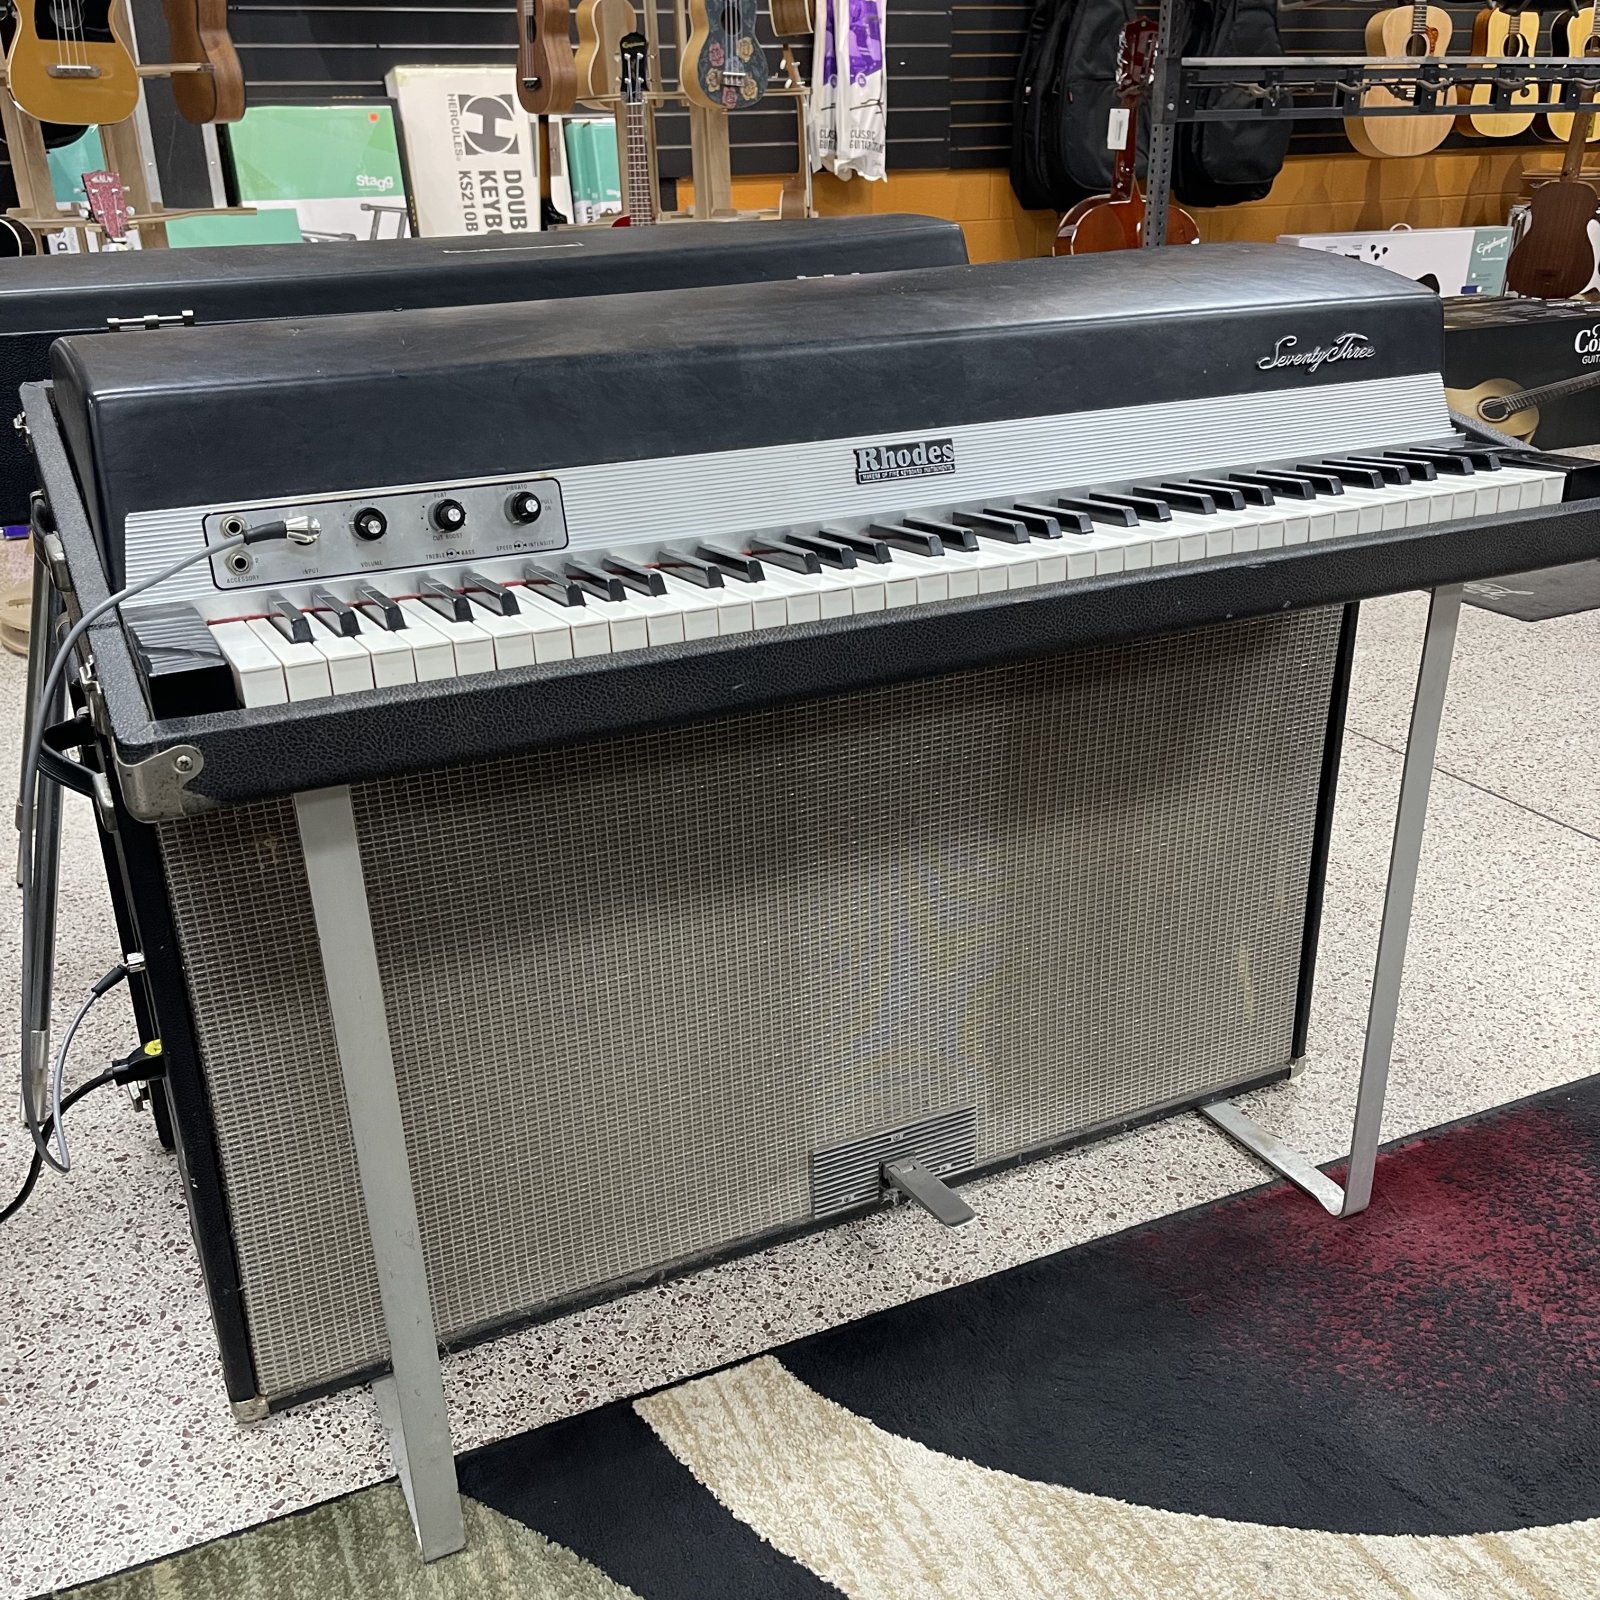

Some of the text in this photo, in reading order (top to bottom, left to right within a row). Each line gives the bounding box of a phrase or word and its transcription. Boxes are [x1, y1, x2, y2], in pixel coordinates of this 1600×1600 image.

[447, 93, 463, 156] HERCULES
[356, 174, 394, 191] Stagg
[458, 170, 479, 232] KS210B
[503, 170, 528, 230] DOUB
[1574, 329, 1600, 353] Co
[1256, 332, 1376, 373] Seventy Three
[1582, 354, 1600, 365] GUIT
[856, 442, 955, 472] Rhodes
[528, 540, 555, 548] INTENSITY
[361, 560, 383, 568] VOLUME
[426, 552, 446, 560] TREBLE
[226, 575, 260, 584] ACCESSORY
